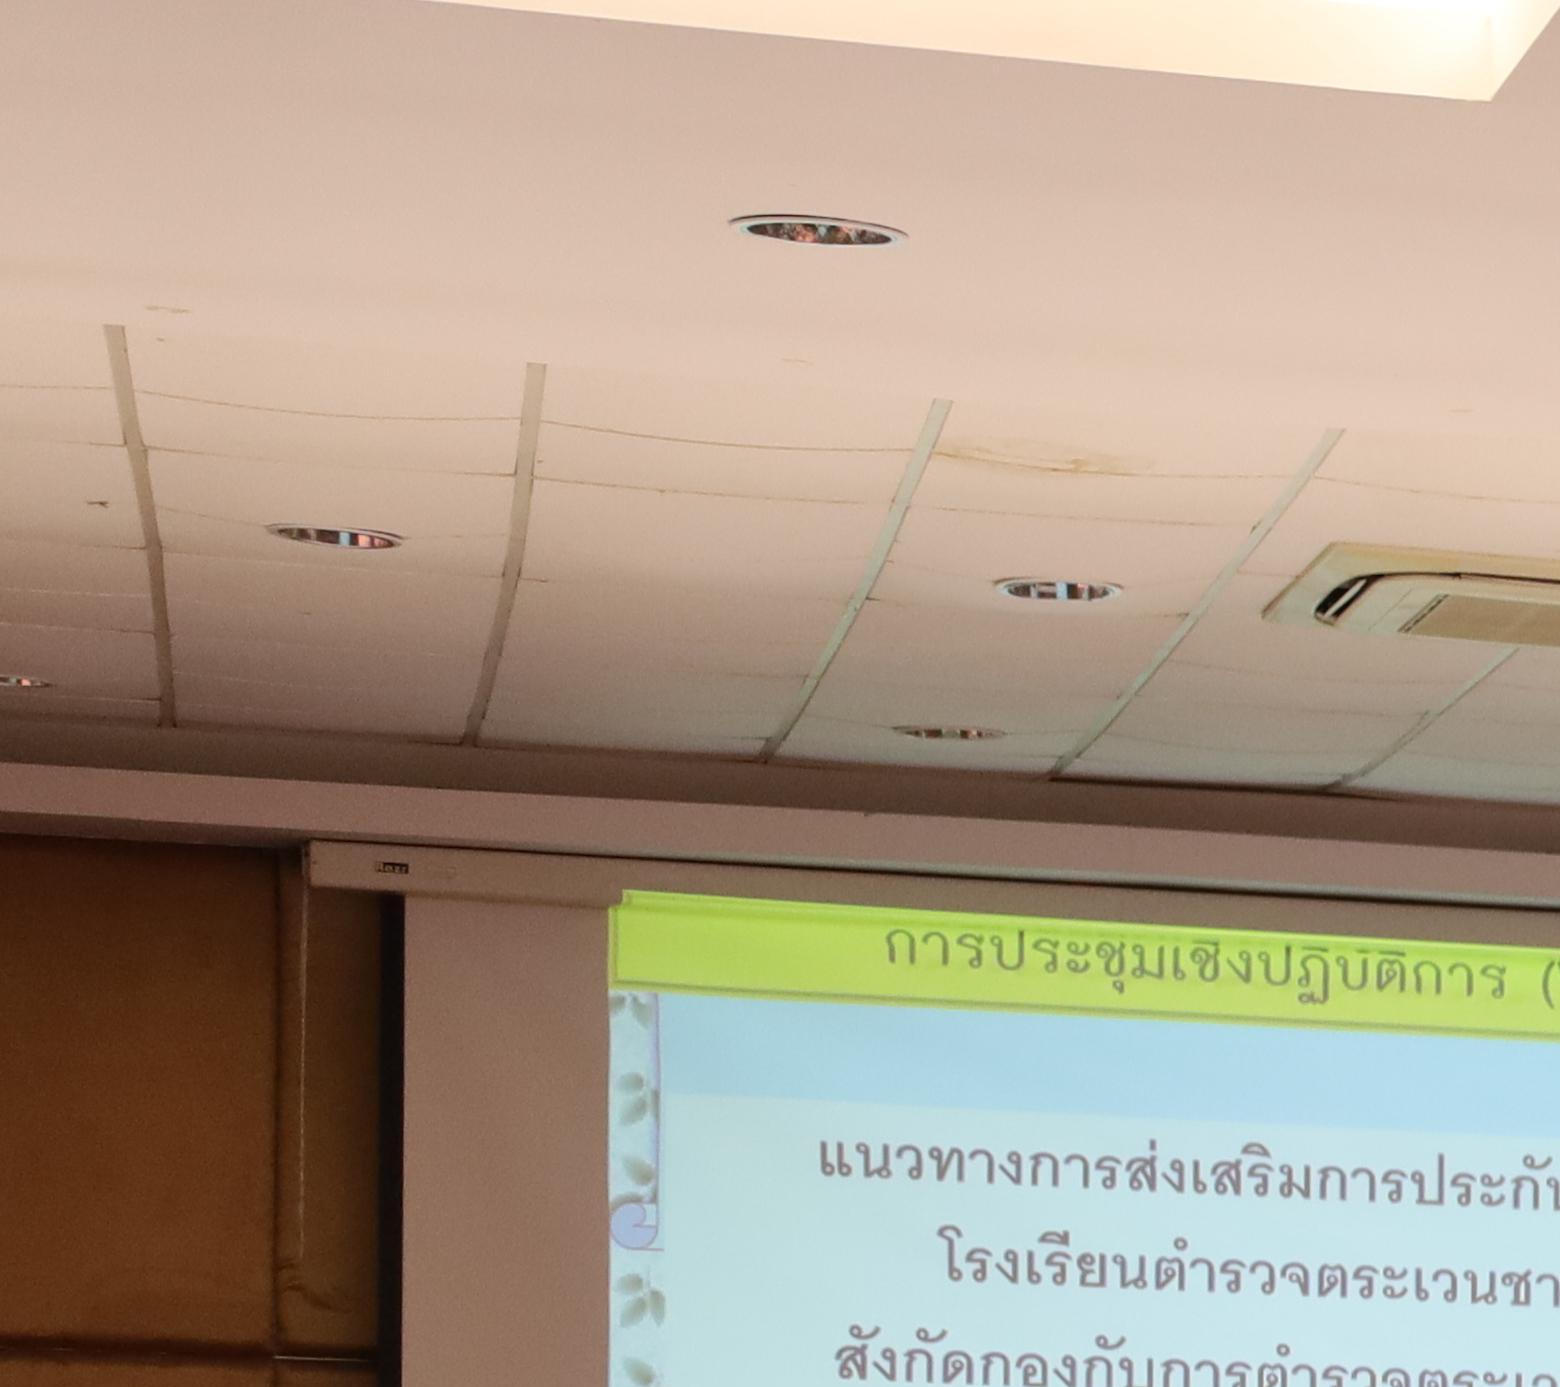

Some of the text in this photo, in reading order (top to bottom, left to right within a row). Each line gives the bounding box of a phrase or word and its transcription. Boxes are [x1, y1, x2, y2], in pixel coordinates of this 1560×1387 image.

[885, 927, 1507, 1004] การประชุมเชงปฏบตการ
